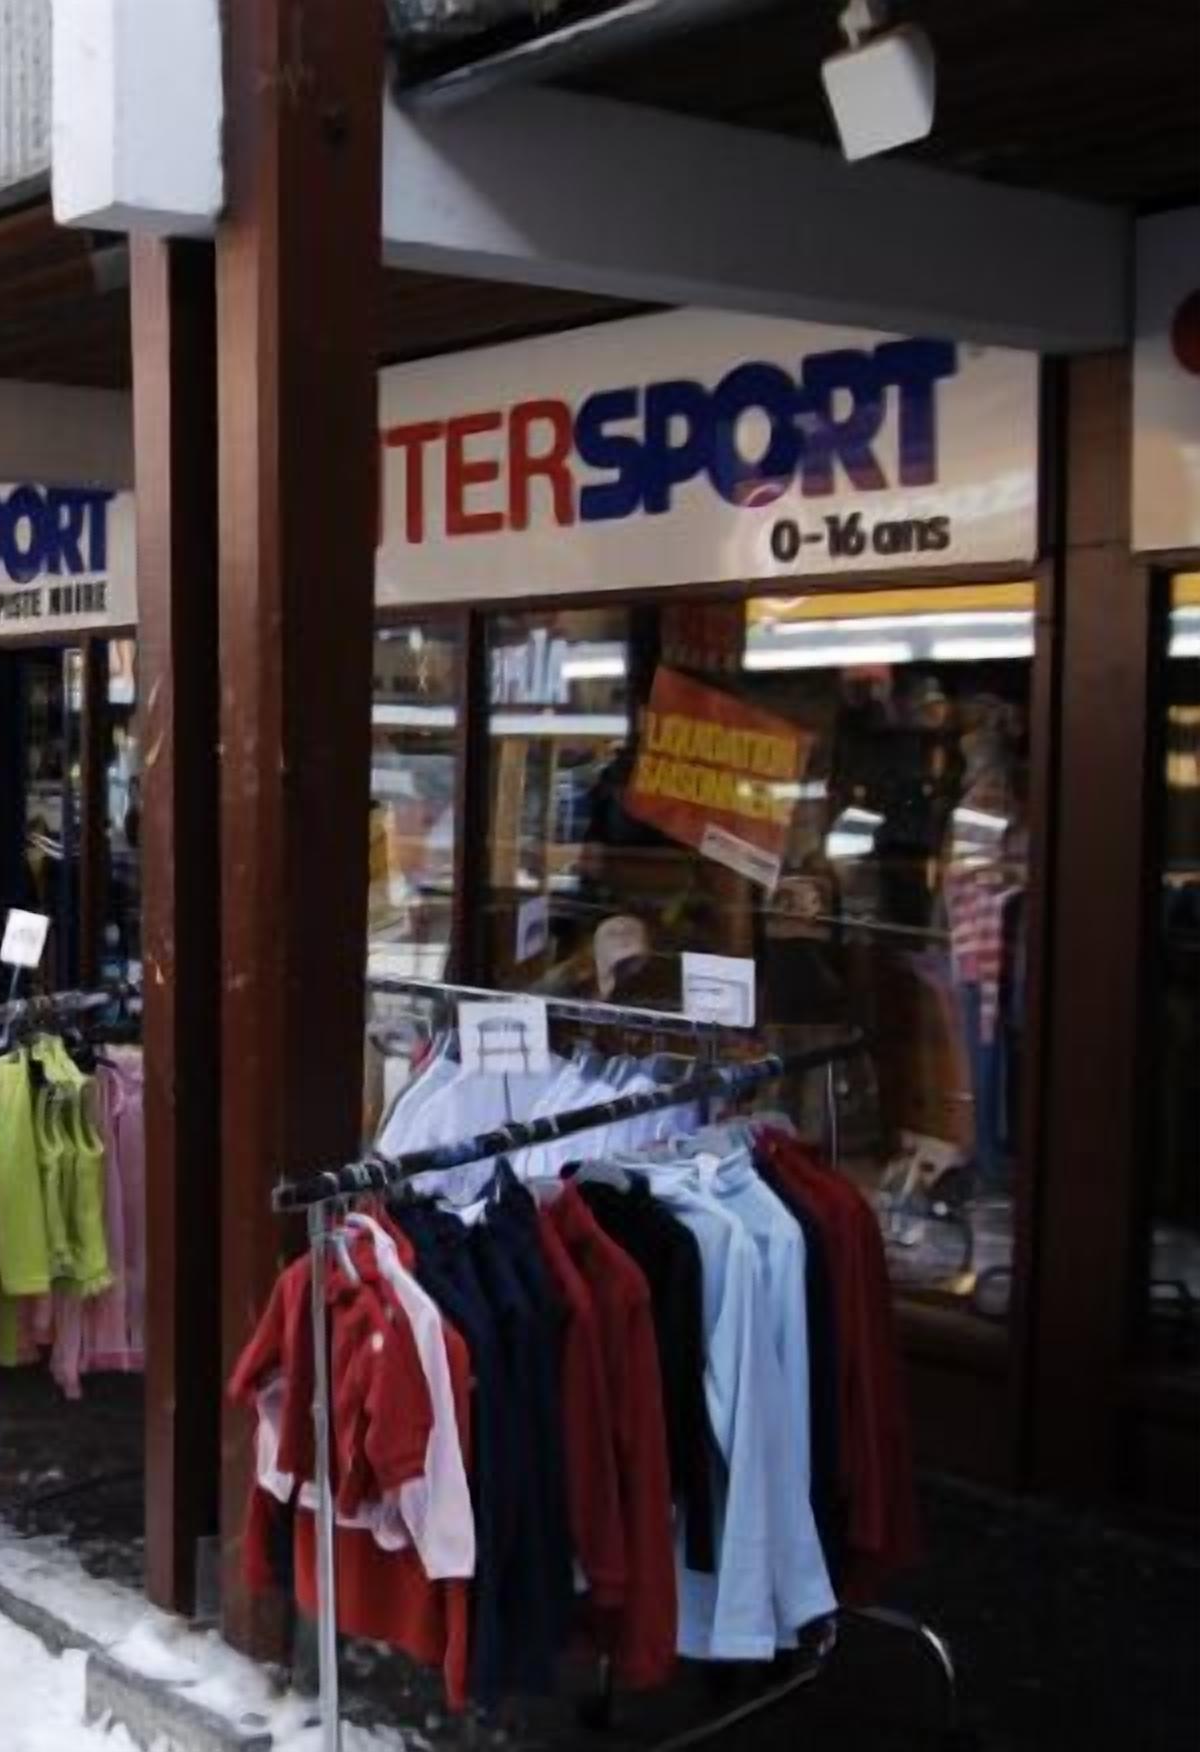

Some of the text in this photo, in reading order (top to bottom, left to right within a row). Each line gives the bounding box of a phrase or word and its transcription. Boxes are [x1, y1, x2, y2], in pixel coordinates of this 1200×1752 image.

[375, 337, 957, 549] TERSPORT
[770, 512, 952, 563] 0-16 ans
